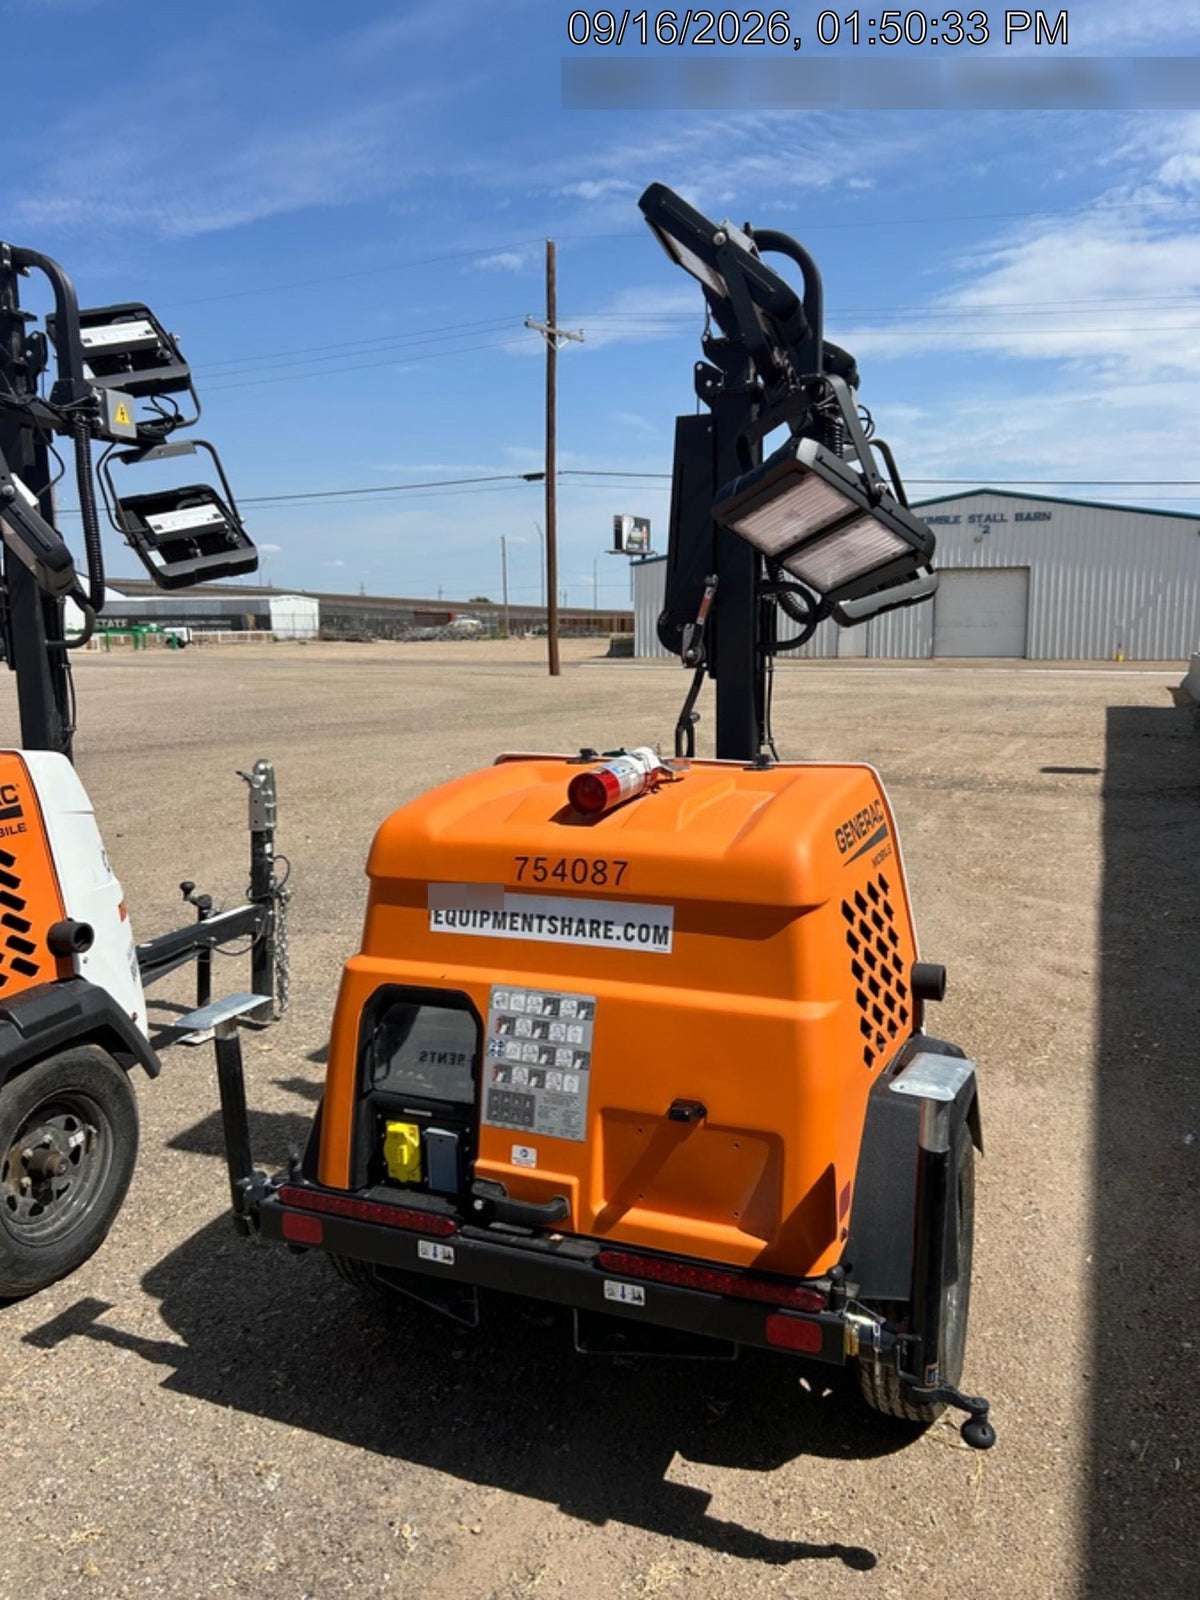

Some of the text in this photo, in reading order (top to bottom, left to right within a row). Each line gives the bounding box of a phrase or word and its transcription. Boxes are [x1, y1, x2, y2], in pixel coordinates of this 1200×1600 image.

[968, 513, 1008, 523] STALL
[1014, 511, 1052, 522] BARN
[835, 800, 883, 853] GENERAC
[514, 856, 628, 886] 754087
[433, 909, 669, 946] EQUIPMENTSHARE.COM
